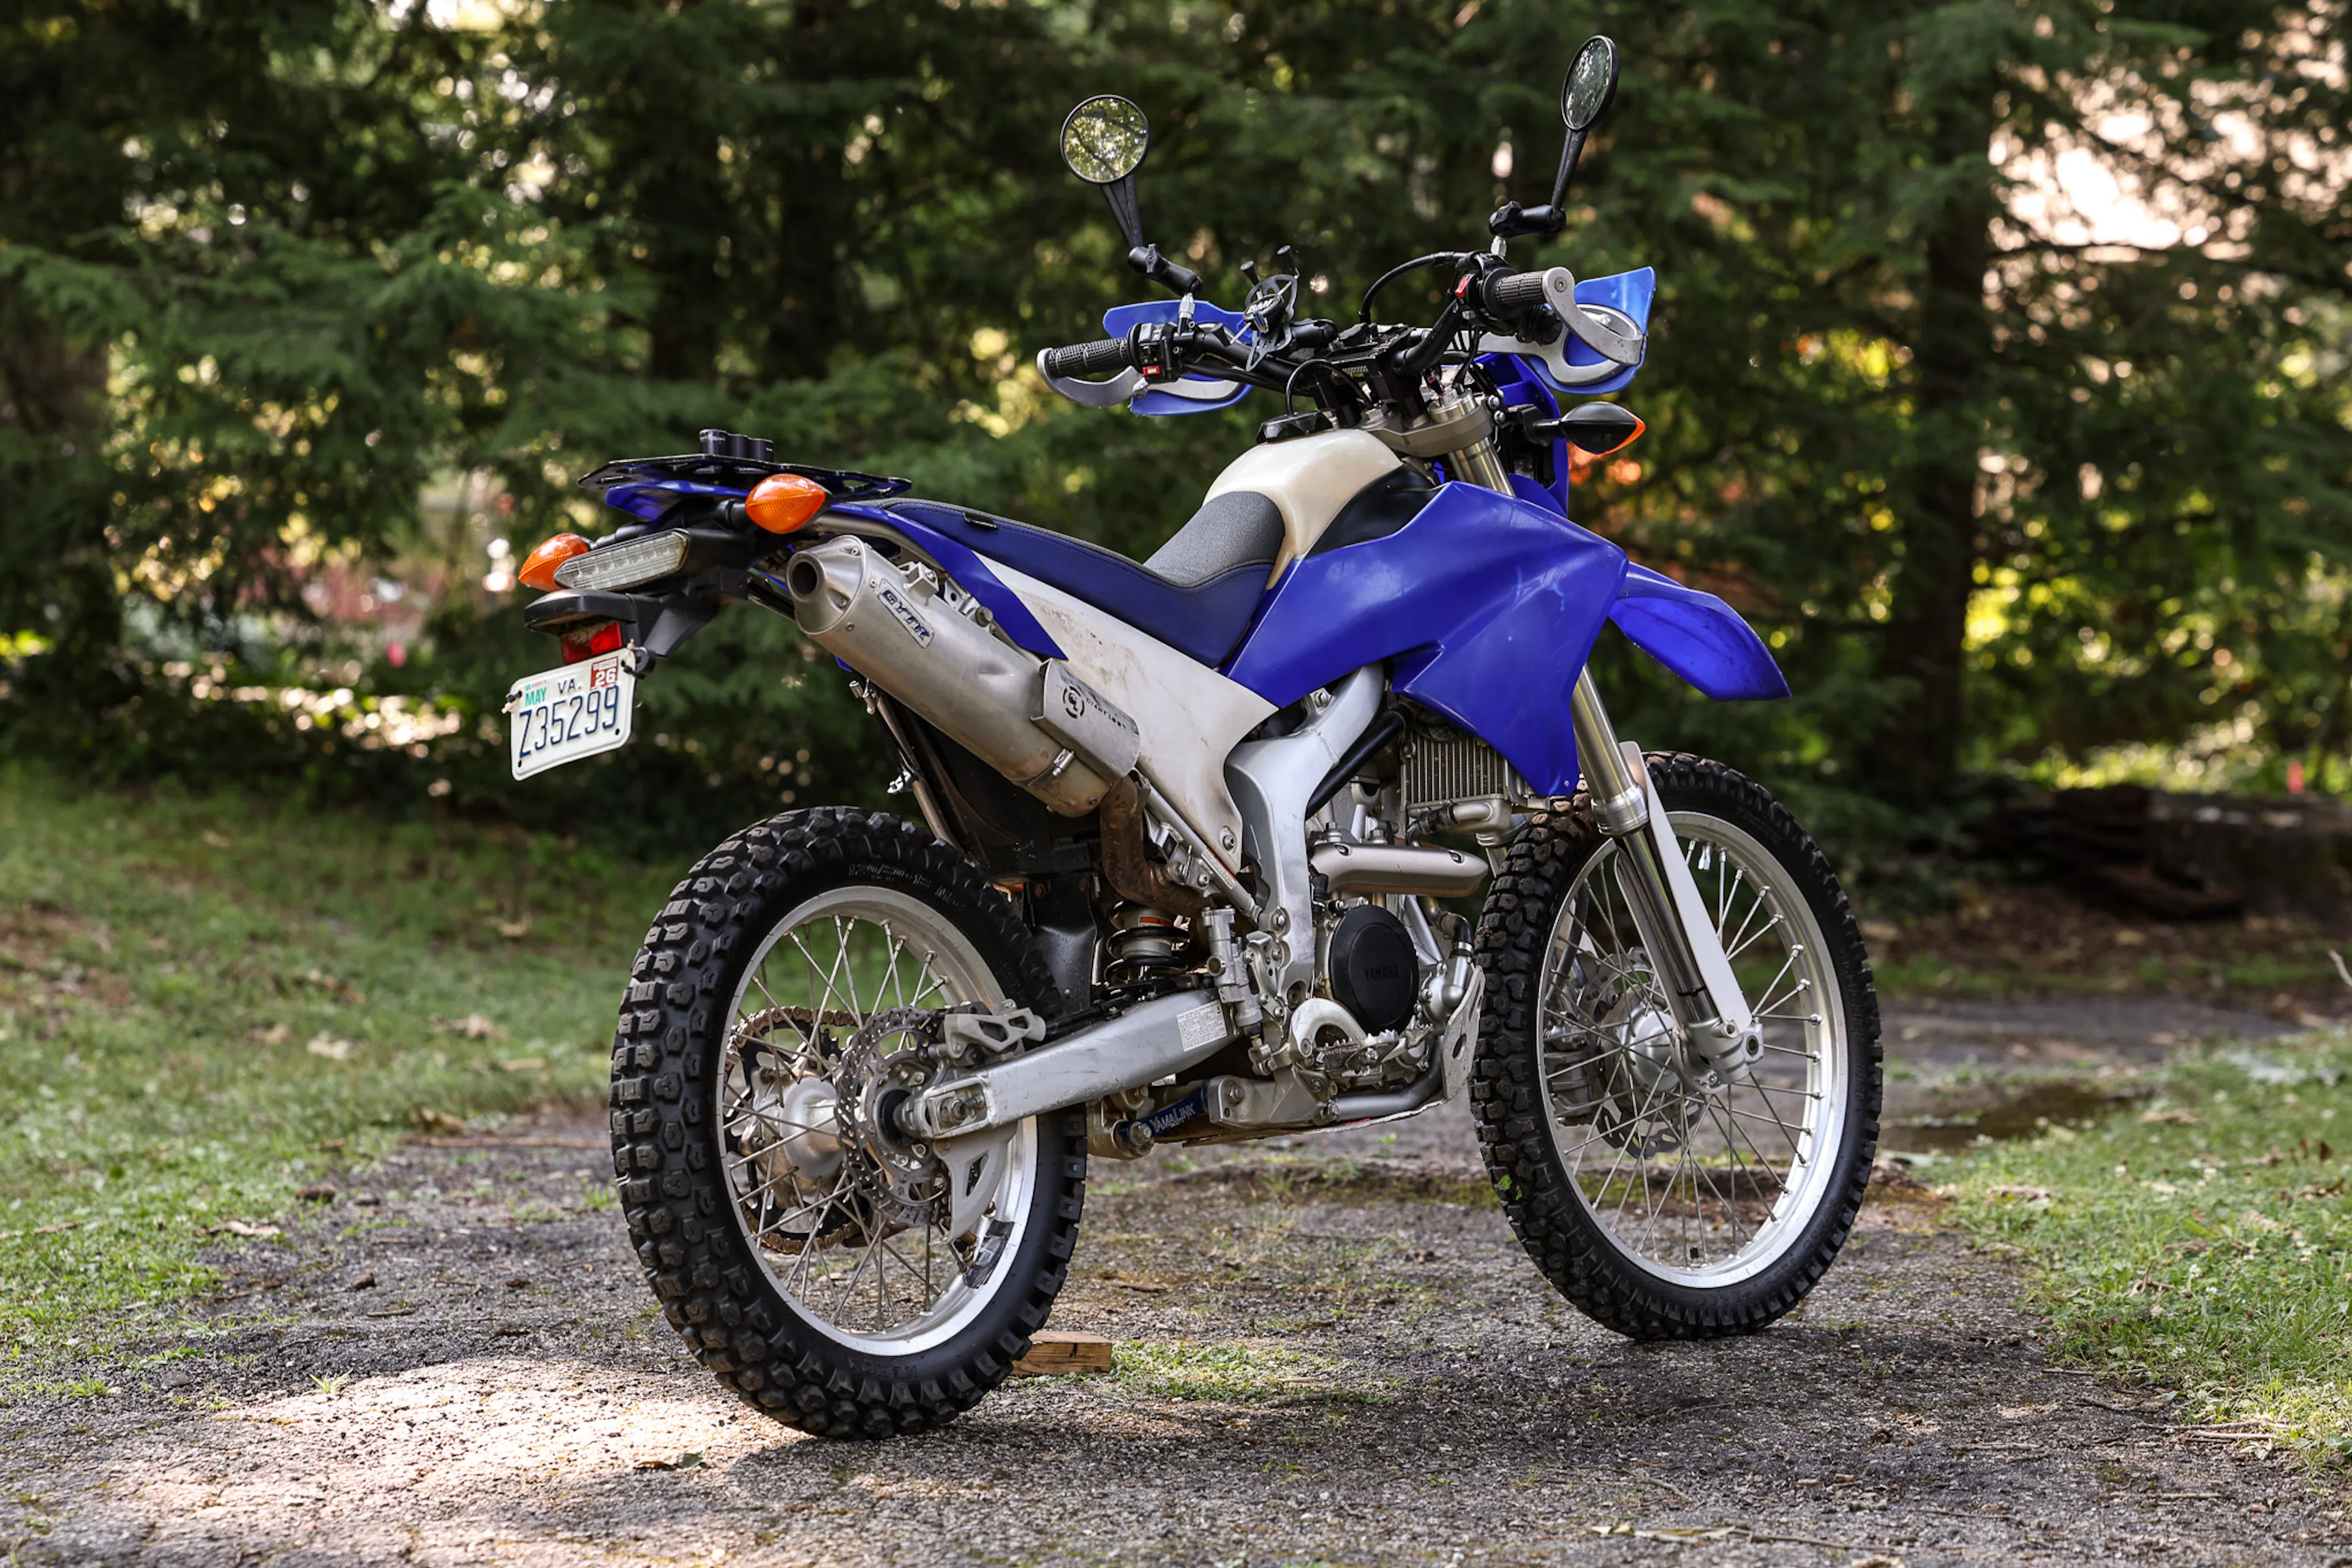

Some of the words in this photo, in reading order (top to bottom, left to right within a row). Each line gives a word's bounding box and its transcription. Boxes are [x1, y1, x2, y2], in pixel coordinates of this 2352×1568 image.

[881, 589, 930, 641] GYTR
[594, 668, 617, 687] 26
[525, 687, 547, 707] MAY
[519, 684, 619, 759] Z35299
[1364, 965, 1400, 981] YAMAHA
